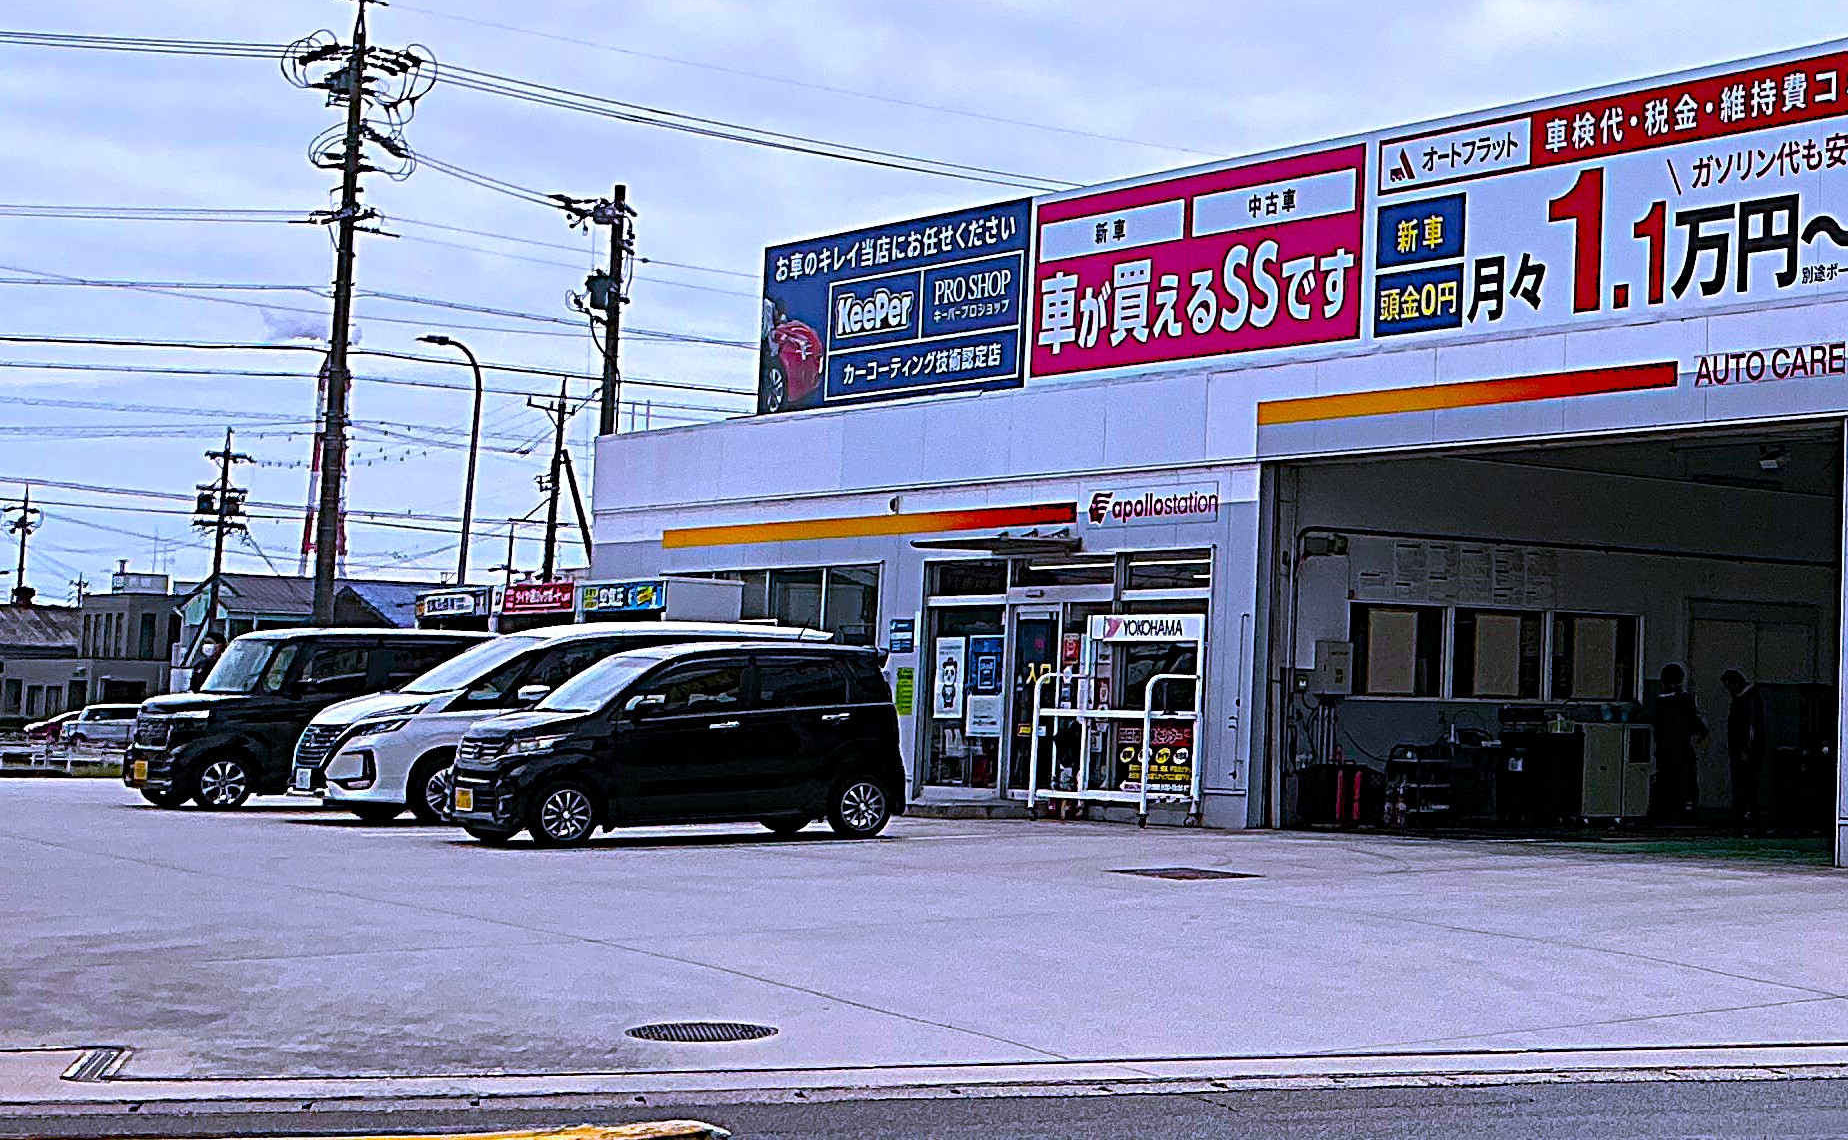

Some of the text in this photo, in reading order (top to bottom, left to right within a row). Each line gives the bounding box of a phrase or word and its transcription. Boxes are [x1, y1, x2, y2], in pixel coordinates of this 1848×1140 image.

[1422, 132, 1518, 172] オートフラット
[1248, 188, 1297, 218] 中古車
[775, 215, 1016, 282] お車のキレイ当店にお任せください
[1095, 219, 1127, 245] 新車
[1397, 215, 1444, 253] 新車
[934, 269, 1011, 306] PRO SHOP
[1038, 241, 1355, 355] 車が買えるSSです
[1380, 281, 1457, 321] 頭金0円
[836, 289, 914, 337] KeePer
[843, 342, 1001, 385] カーコーティング技術認定店
[1695, 342, 1845, 388] AUTO CARE
[1112, 491, 1218, 524] apollostation
[1123, 619, 1183, 636] YOKOHAMA
